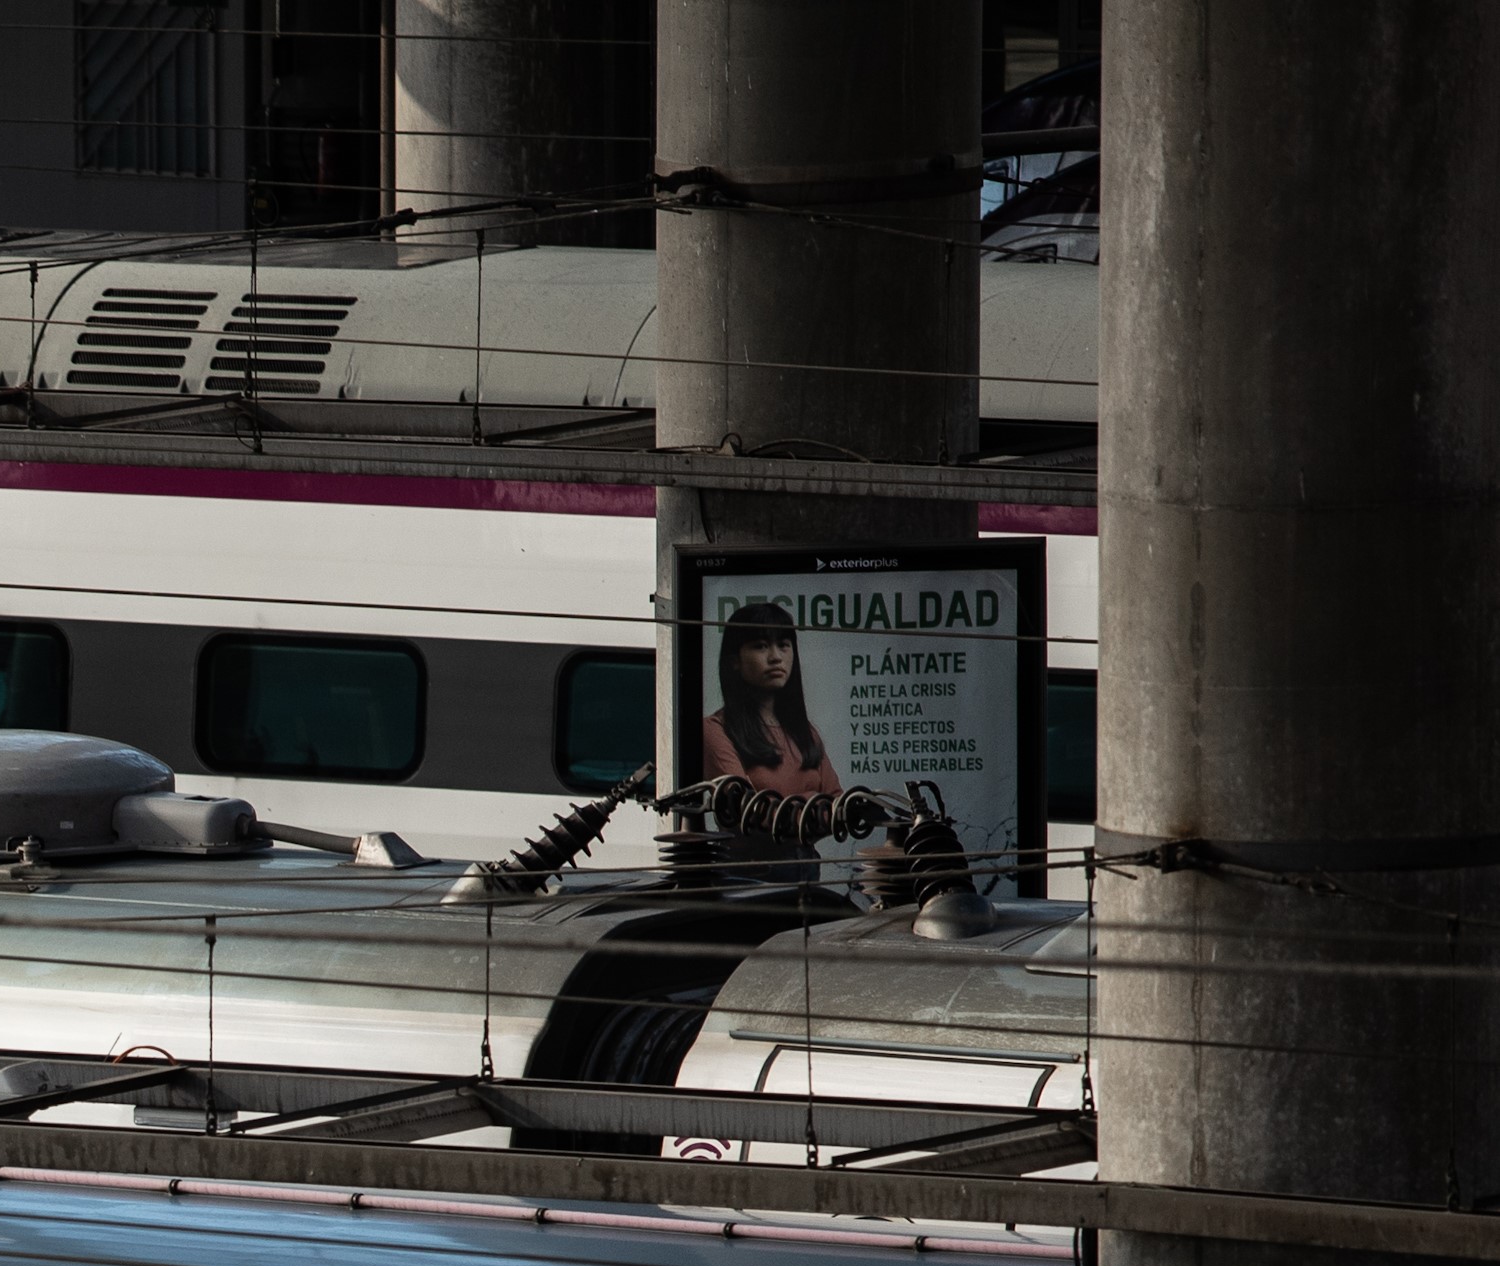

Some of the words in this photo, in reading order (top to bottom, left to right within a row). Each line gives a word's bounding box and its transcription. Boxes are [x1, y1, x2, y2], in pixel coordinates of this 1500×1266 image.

[696, 557, 726, 568] 01937
[830, 556, 899, 570] exteriorplus
[717, 590, 999, 633] DIGUALDAD
[851, 647, 967, 676] PLÁNTATE
[850, 685, 886, 699] ANTE
[890, 684, 907, 698] LA
[911, 683, 956, 697] CRISIS
[850, 700, 923, 717] CLIMÁTICA
[851, 723, 859, 736] Y
[863, 722, 889, 736] SUS
[894, 720, 955, 735] EFECTOS
[851, 741, 868, 755] EN
[873, 741, 899, 755] LAS
[903, 739, 976, 753] PERSONAS
[851, 756, 880, 773] MÁS
[884, 758, 984, 773] VULNERABLES
